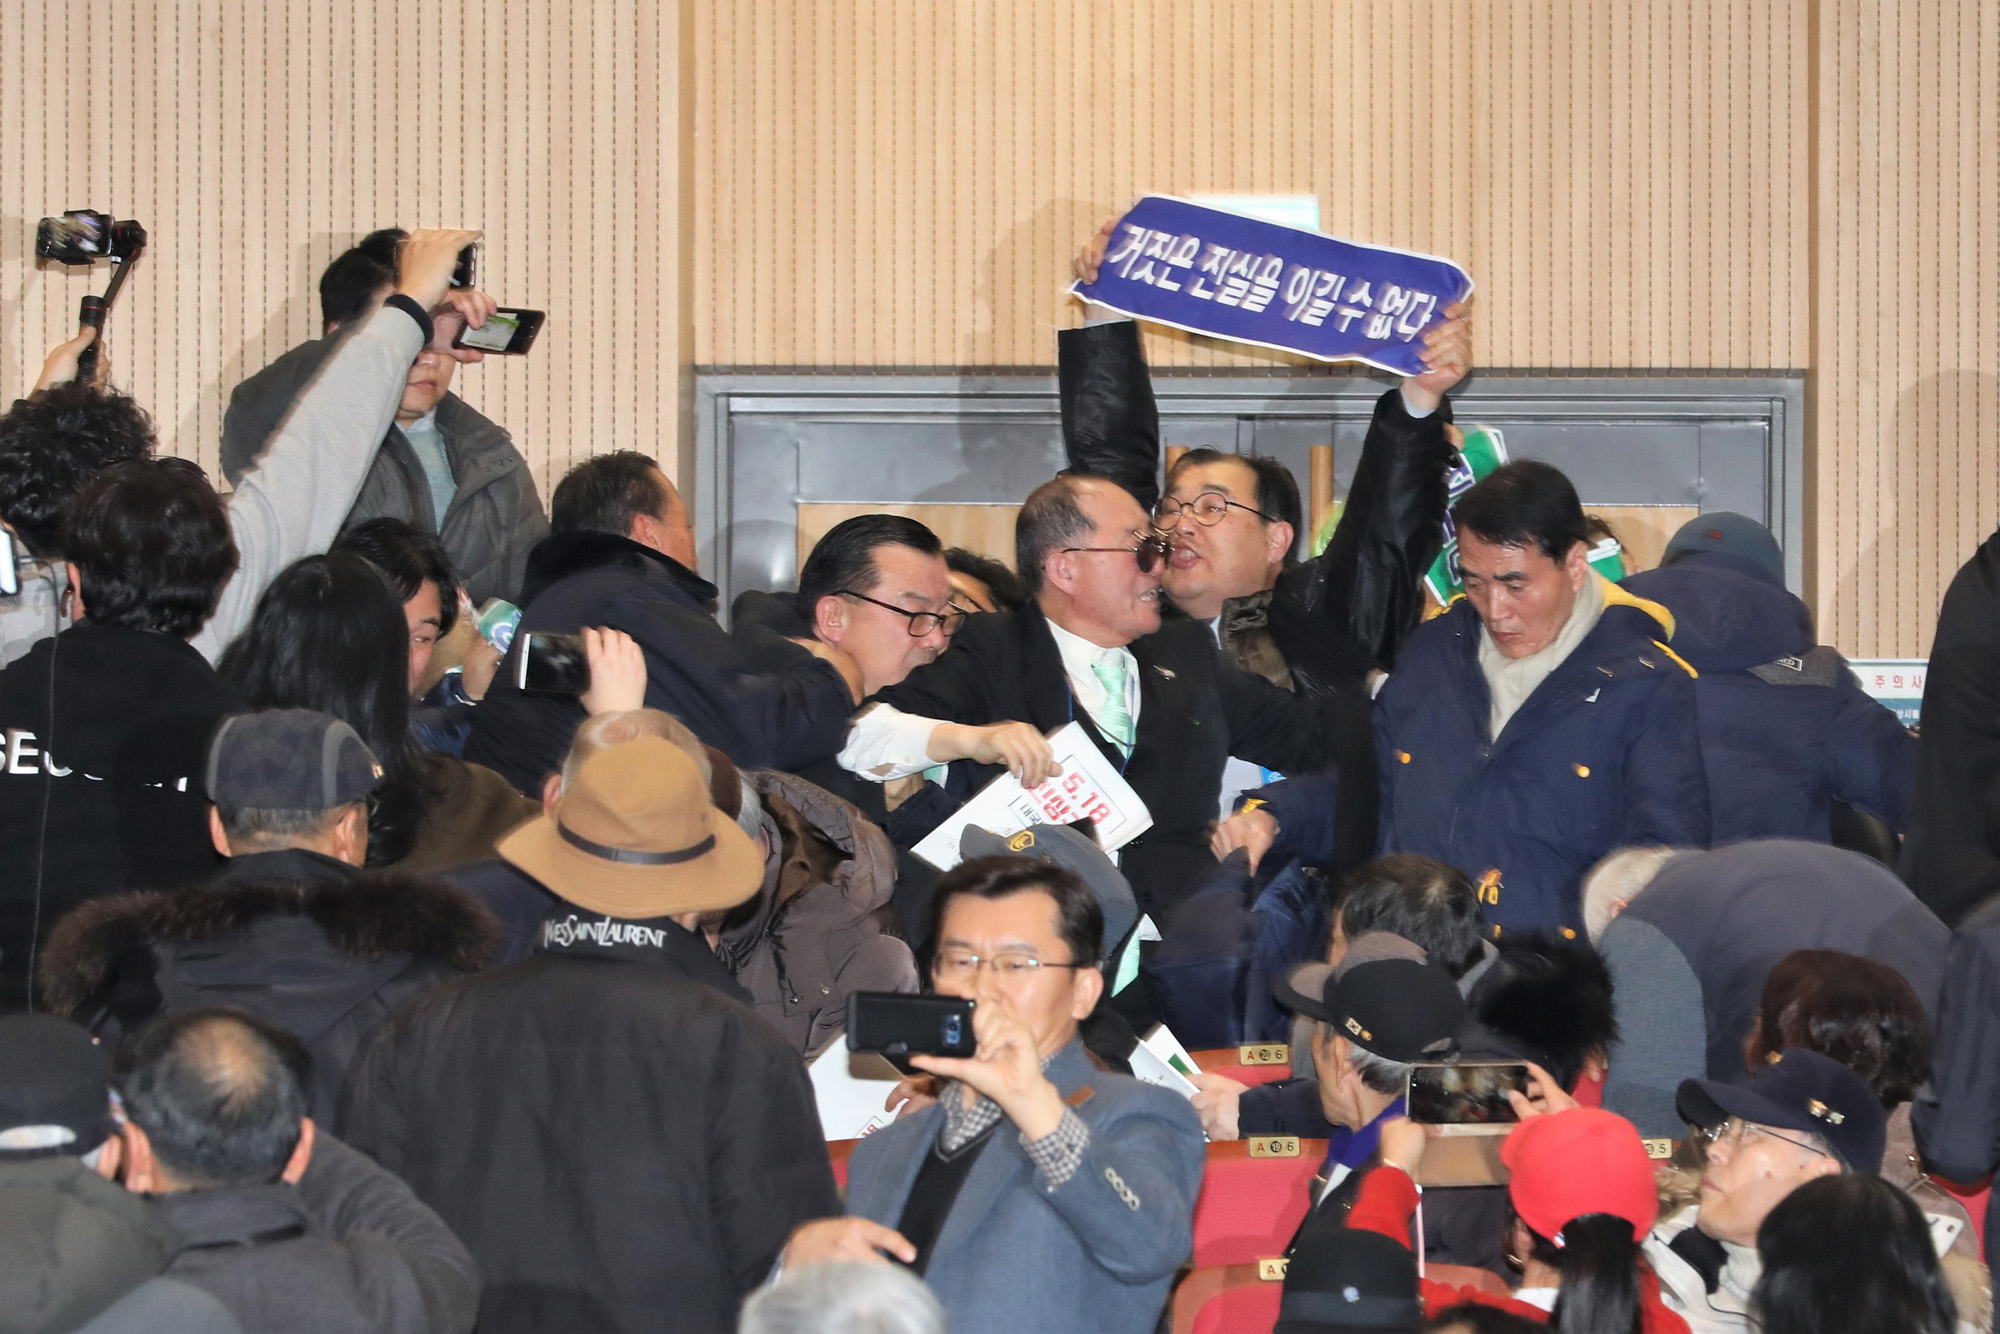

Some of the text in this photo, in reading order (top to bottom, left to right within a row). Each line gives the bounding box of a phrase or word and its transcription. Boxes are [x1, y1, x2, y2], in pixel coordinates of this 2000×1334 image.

[1106, 224, 1200, 292] 거짓은
[1188, 243, 1284, 313] 진실을
[1366, 285, 1438, 343] 없다
[1026, 781, 1081, 825] 진상
[1062, 771, 1112, 825] 5.18
[1247, 1050, 1255, 1060] A
[1275, 1049, 1283, 1060] 6
[1256, 1142, 1265, 1152] A
[1287, 1141, 1294, 1152] 6
[1659, 1143, 1666, 1153] 5
[1267, 1264, 1276, 1275] A
